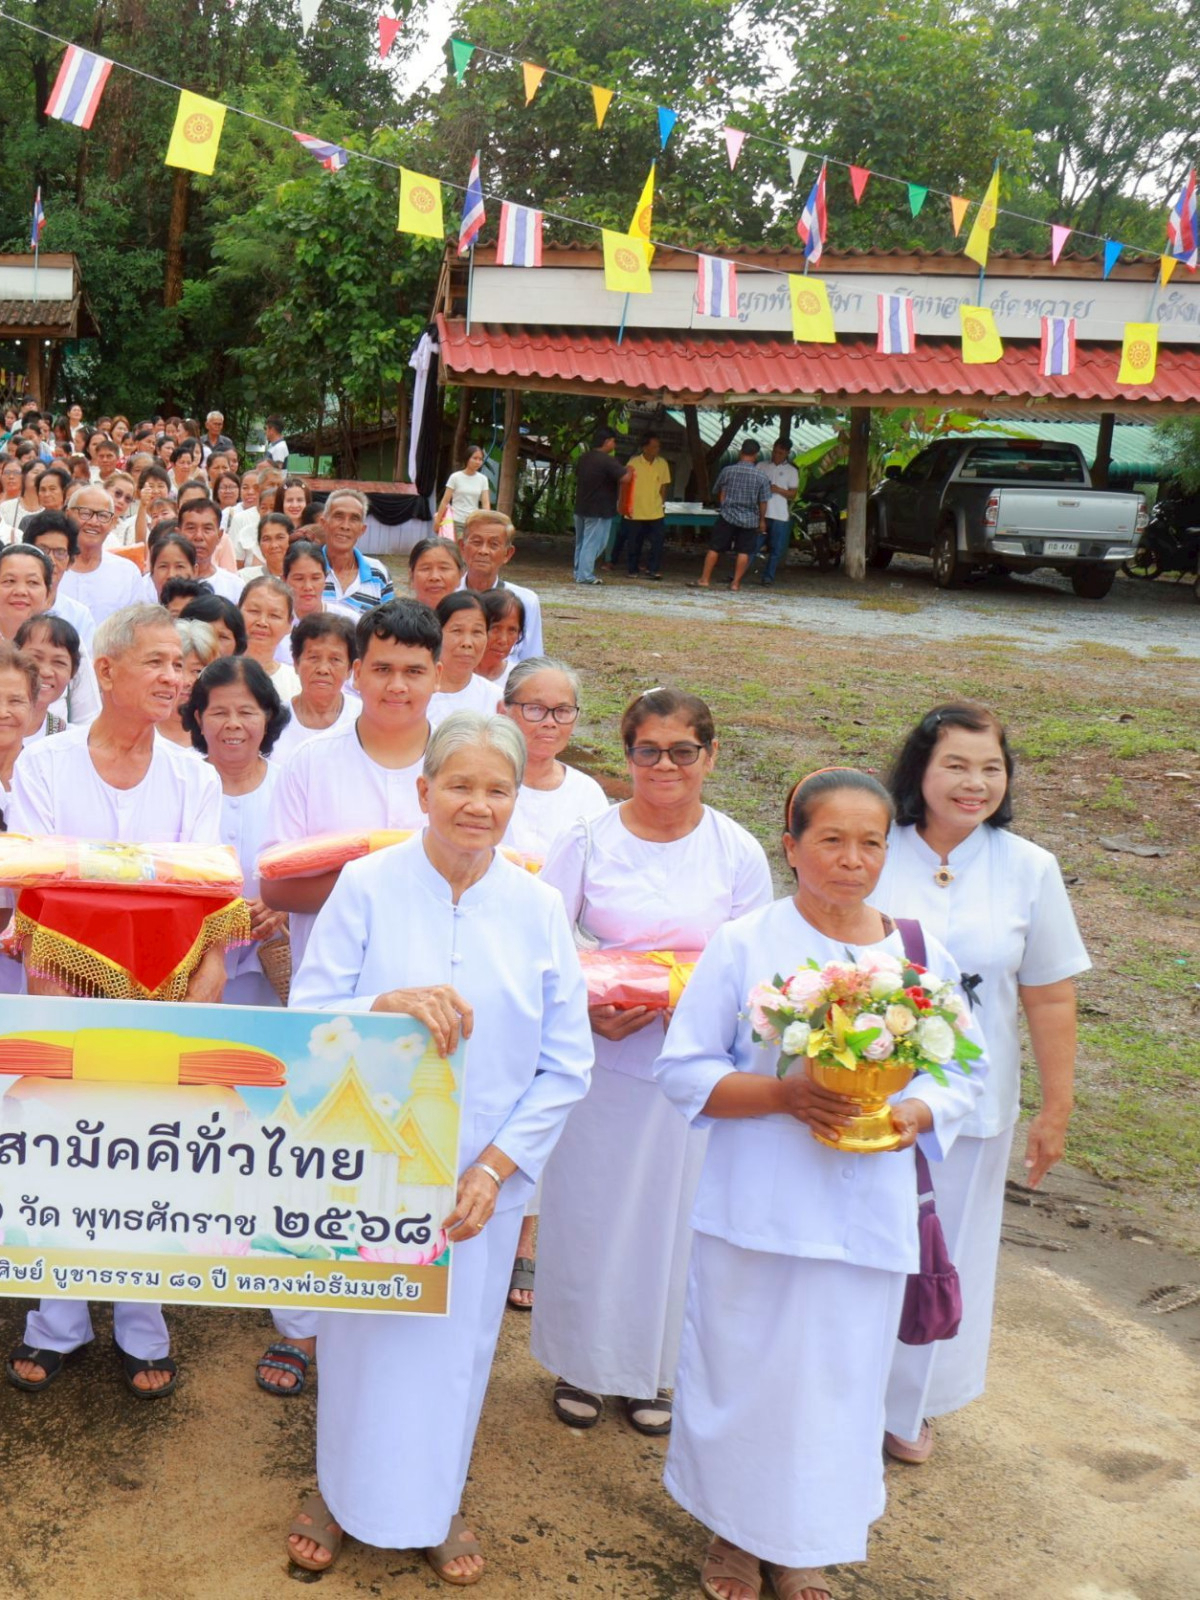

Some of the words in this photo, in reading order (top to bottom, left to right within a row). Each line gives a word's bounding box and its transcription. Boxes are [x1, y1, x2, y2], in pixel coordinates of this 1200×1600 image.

[19, 1195, 60, 1227] วัด
[72, 1200, 257, 1241] พุทธศักราช
[274, 1206, 432, 1245] ๒๕๖๘
[54, 1268, 160, 1290] บูชาธรรม
[169, 1274, 201, 1289] ๘๑
[211, 1268, 227, 1289] ปี
[237, 1274, 420, 1299] หลวงพ่อธัมมชโย
